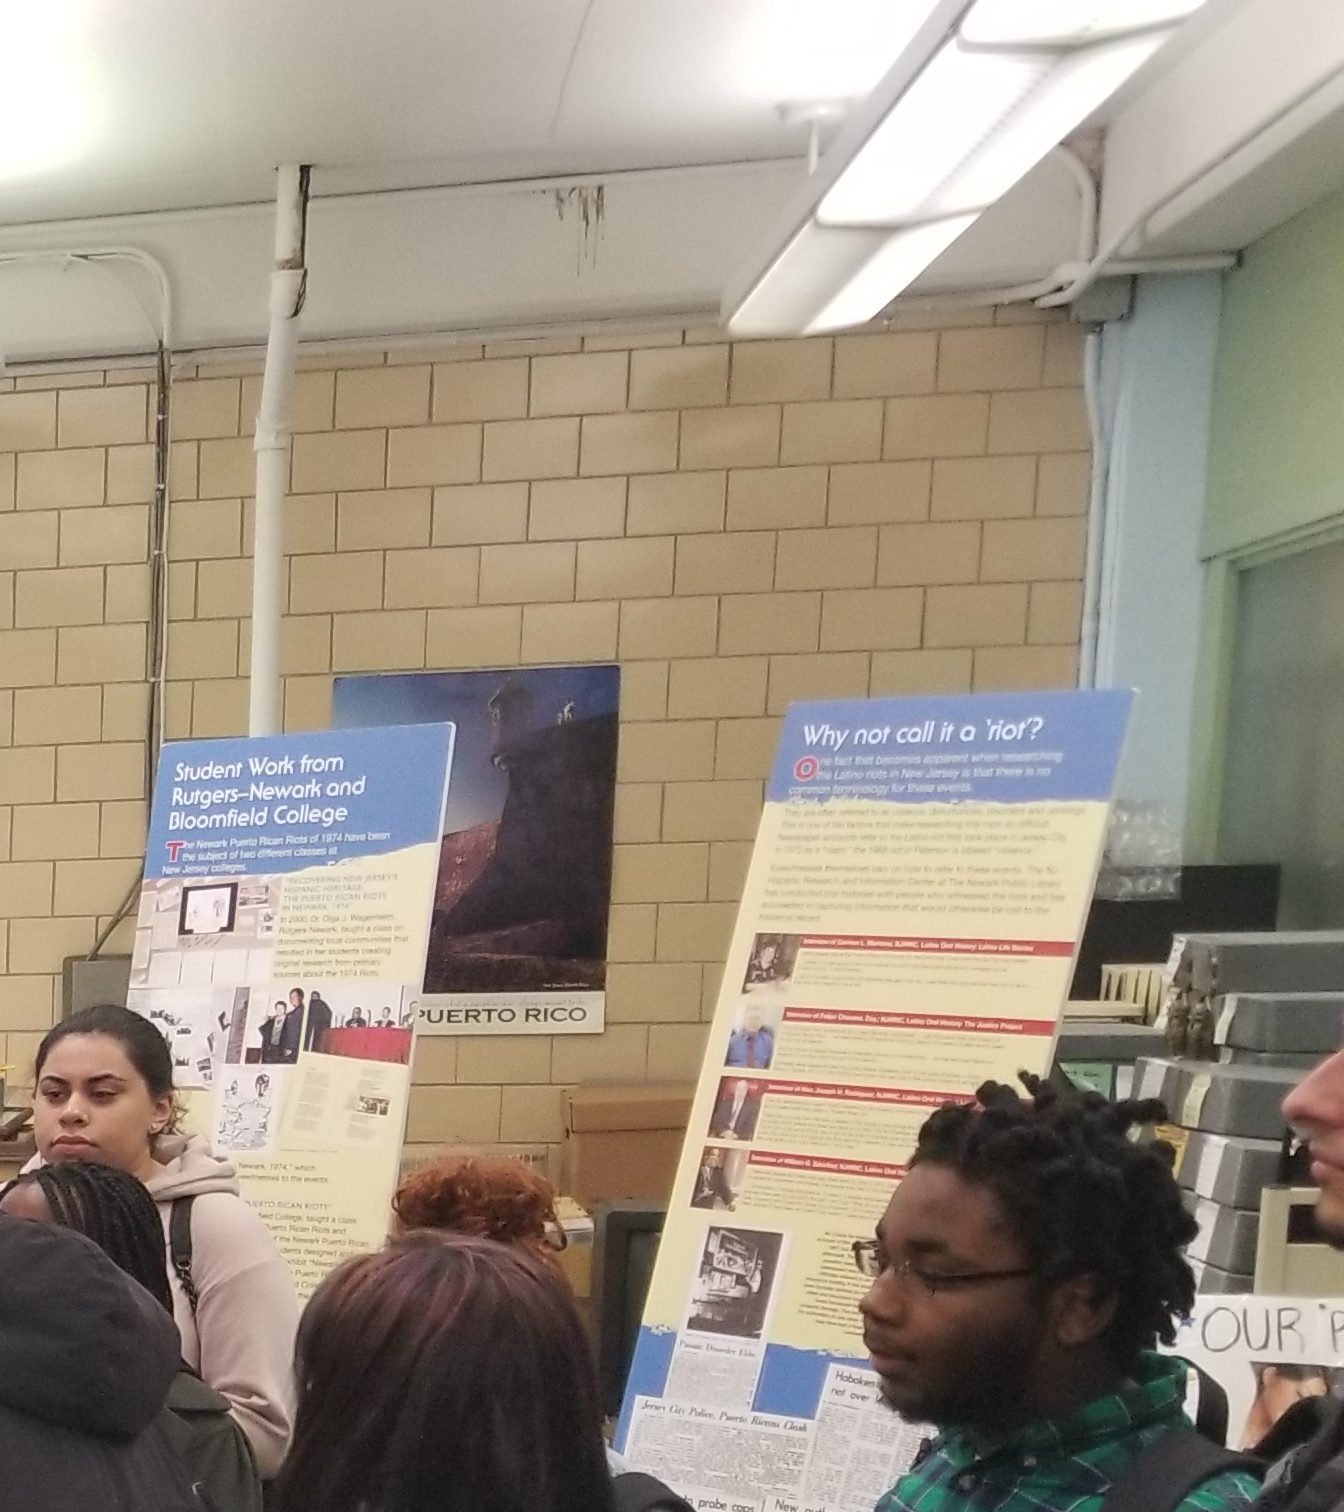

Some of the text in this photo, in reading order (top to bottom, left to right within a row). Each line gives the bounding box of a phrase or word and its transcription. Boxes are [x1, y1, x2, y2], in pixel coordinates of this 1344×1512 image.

[804, 725, 850, 751] Why
[853, 727, 891, 745] not
[896, 721, 936, 744] call
[939, 722, 955, 742] it
[959, 726, 976, 741] a
[174, 754, 344, 782] Student Work from
[834, 768, 961, 780] Latino New Jersey
[326, 776, 366, 795] and
[168, 804, 348, 831] Bloomfield College
[165, 840, 194, 862] The
[196, 839, 227, 849] Newark
[230, 837, 258, 848] Puerto
[259, 836, 283, 847] Rican
[286, 835, 309, 845] Riots
[310, 834, 321, 844] of
[321, 833, 342, 843] 1974
[344, 832, 367, 842] have
[182, 852, 196, 861] the
[197, 850, 227, 863] subject
[229, 850, 239, 860] of
[240, 849, 256, 859] two
[162, 865, 210, 876] New Jersey
[524, 1007, 587, 1022] RICO
[1201, 1306, 1306, 1353] OUR
[835, 1371, 876, 1388] Hoboken
[831, 1387, 869, 1402] riot over
[669, 1405, 685, 1415] City
[719, 1412, 748, 1424] Puerto
[784, 1420, 807, 1432] Clash
[698, 1498, 727, 1511] probe
[775, 1498, 798, 1512] New
